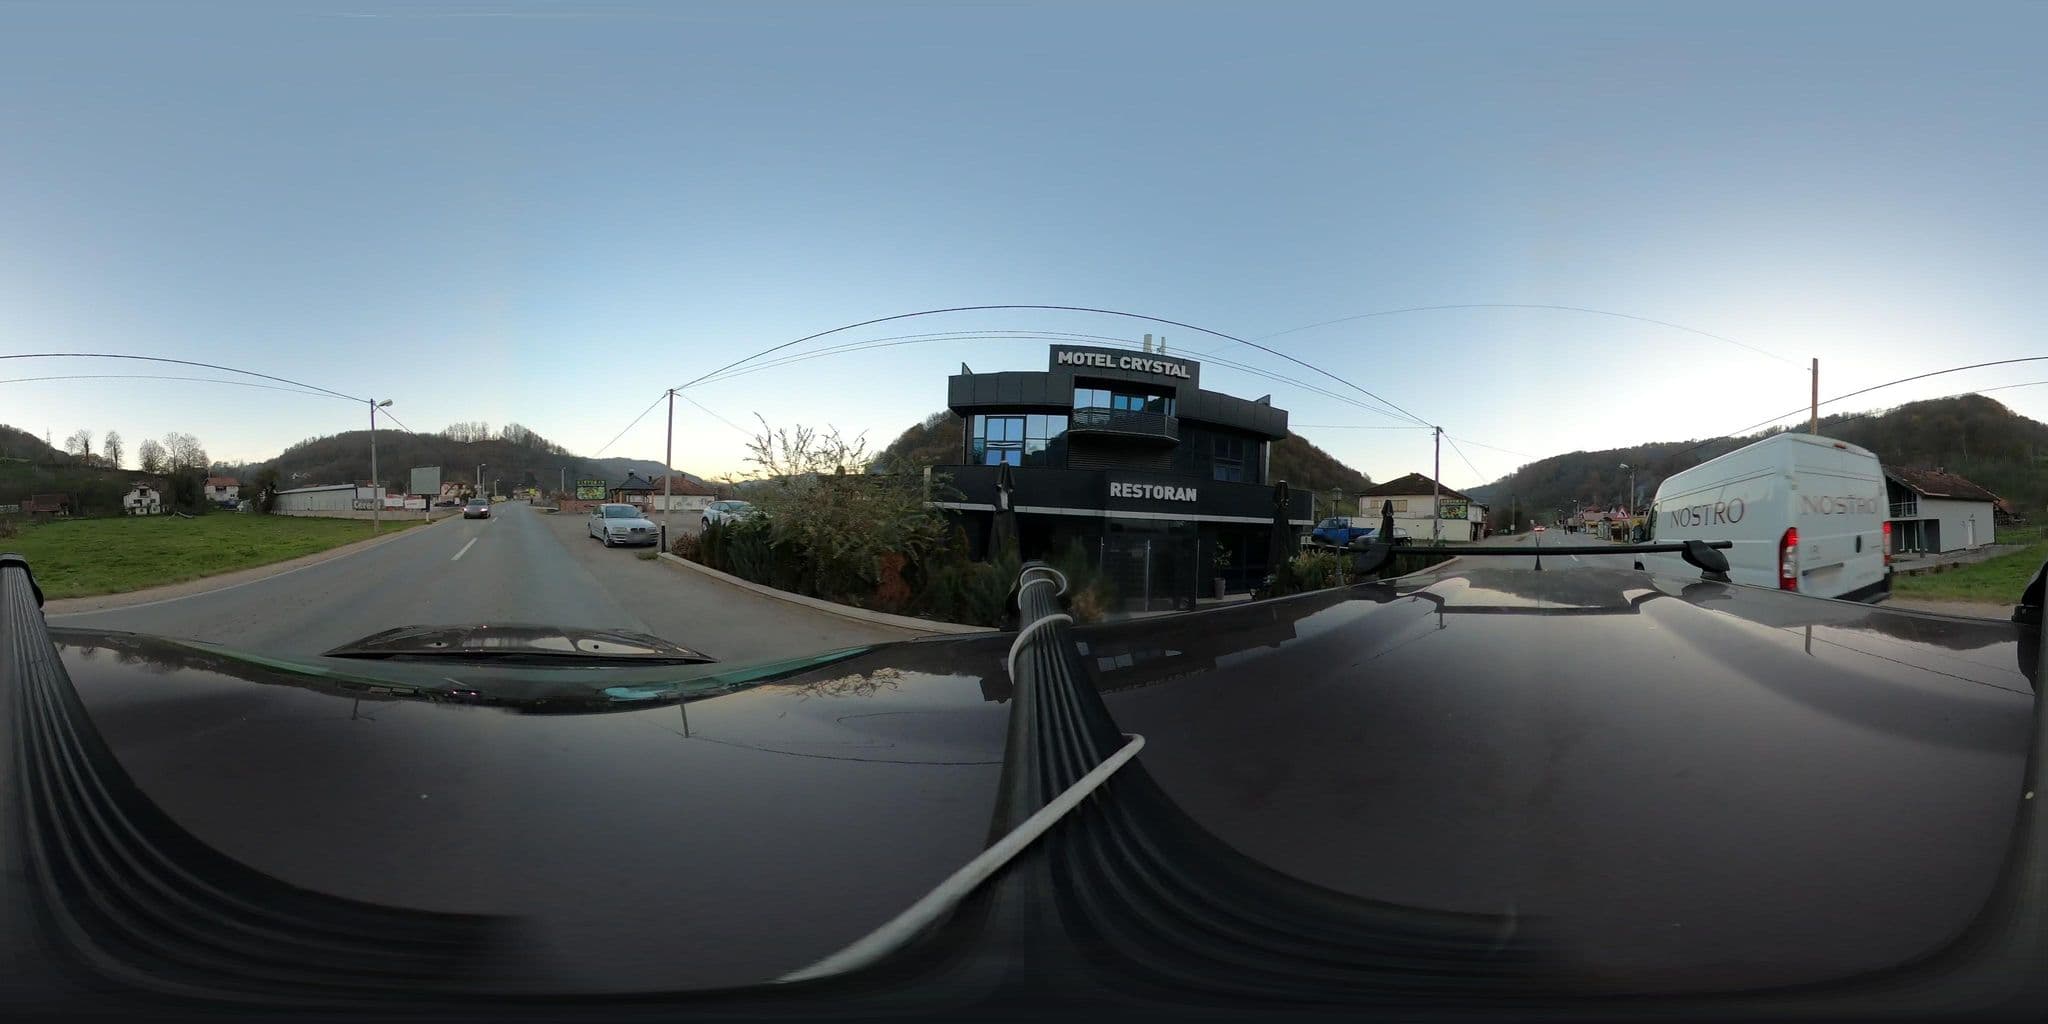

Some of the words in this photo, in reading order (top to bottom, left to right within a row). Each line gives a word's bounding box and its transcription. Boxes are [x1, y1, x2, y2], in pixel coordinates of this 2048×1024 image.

[1058, 351, 1116, 368] MOTEL
[1119, 356, 1191, 378] CRYSTAL
[1110, 481, 1197, 502] RESTORAN
[1671, 498, 1745, 529] NOSTRO
[1802, 495, 1876, 515] NOSTRO
